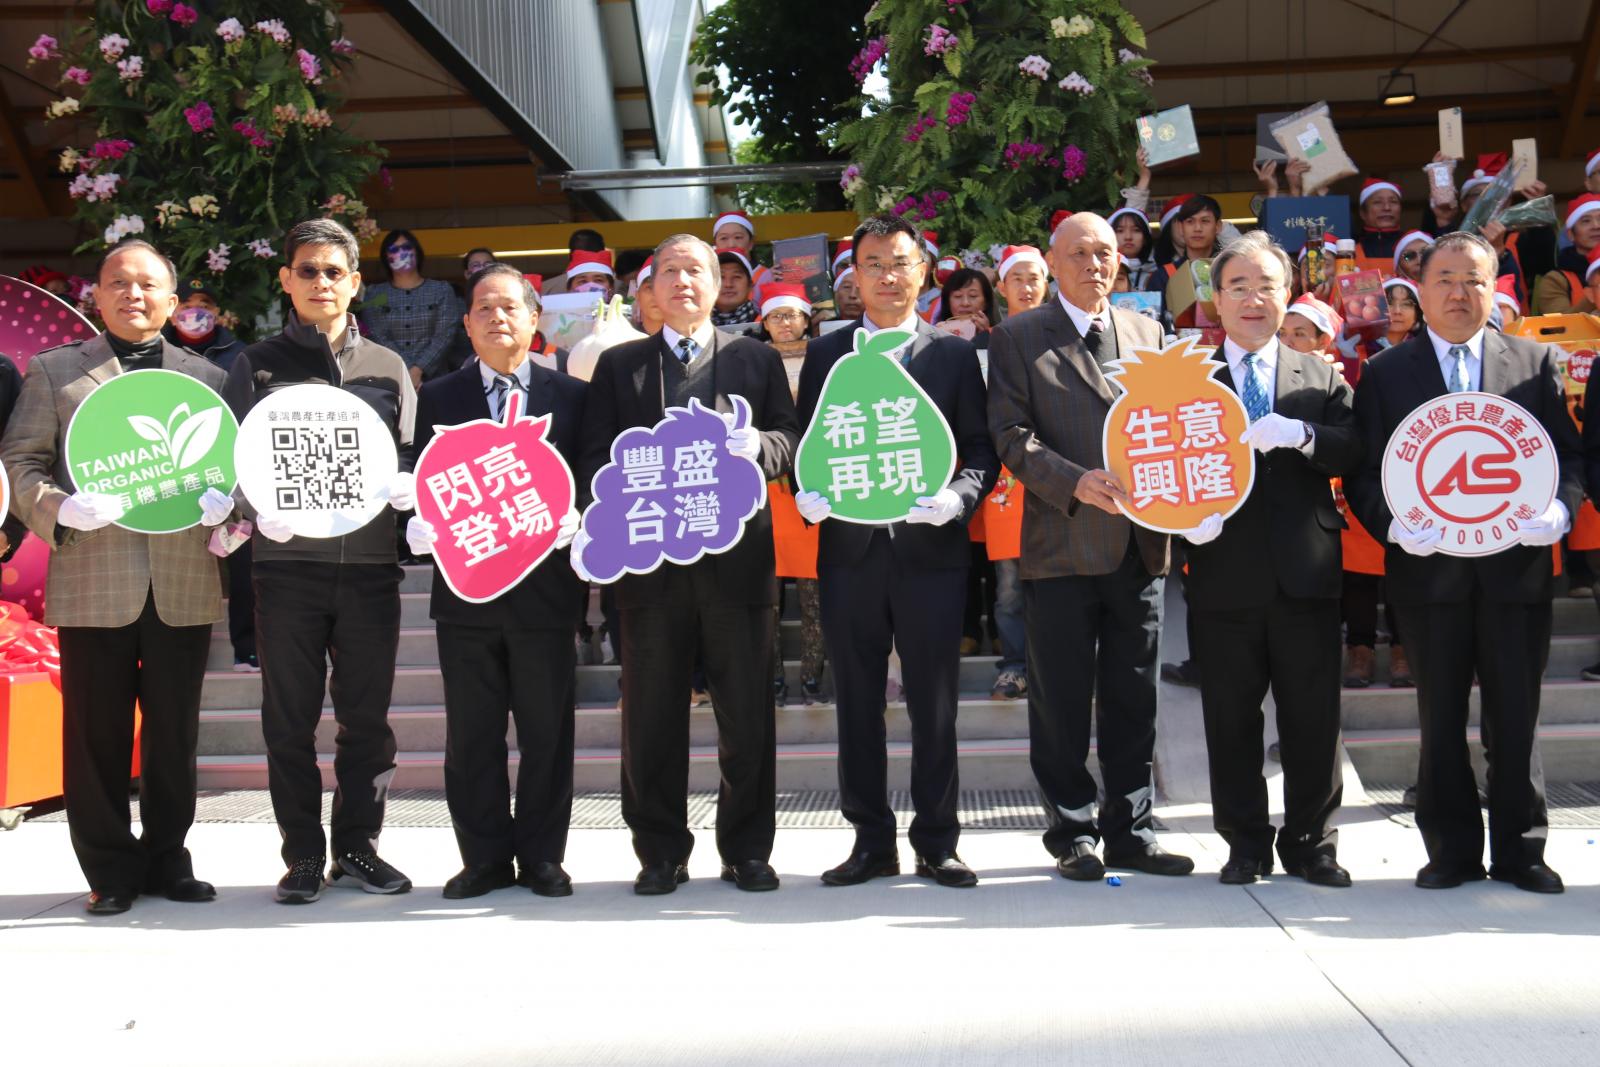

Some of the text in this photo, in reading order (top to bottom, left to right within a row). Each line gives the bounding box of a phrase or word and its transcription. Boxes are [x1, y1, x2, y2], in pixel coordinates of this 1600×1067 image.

[822, 396, 921, 450] 希望
[1126, 401, 1226, 458] 生意
[1395, 401, 1544, 464] 台灣優良農產品
[76, 441, 169, 478] TAIWAN
[83, 461, 174, 495] ORGANIC
[425, 441, 532, 521] 閃亮
[621, 439, 720, 494] 豐盛
[826, 448, 928, 502] 再現
[1131, 452, 1237, 510] 興隆
[449, 487, 554, 568] 登場
[624, 490, 722, 545] 台灣
